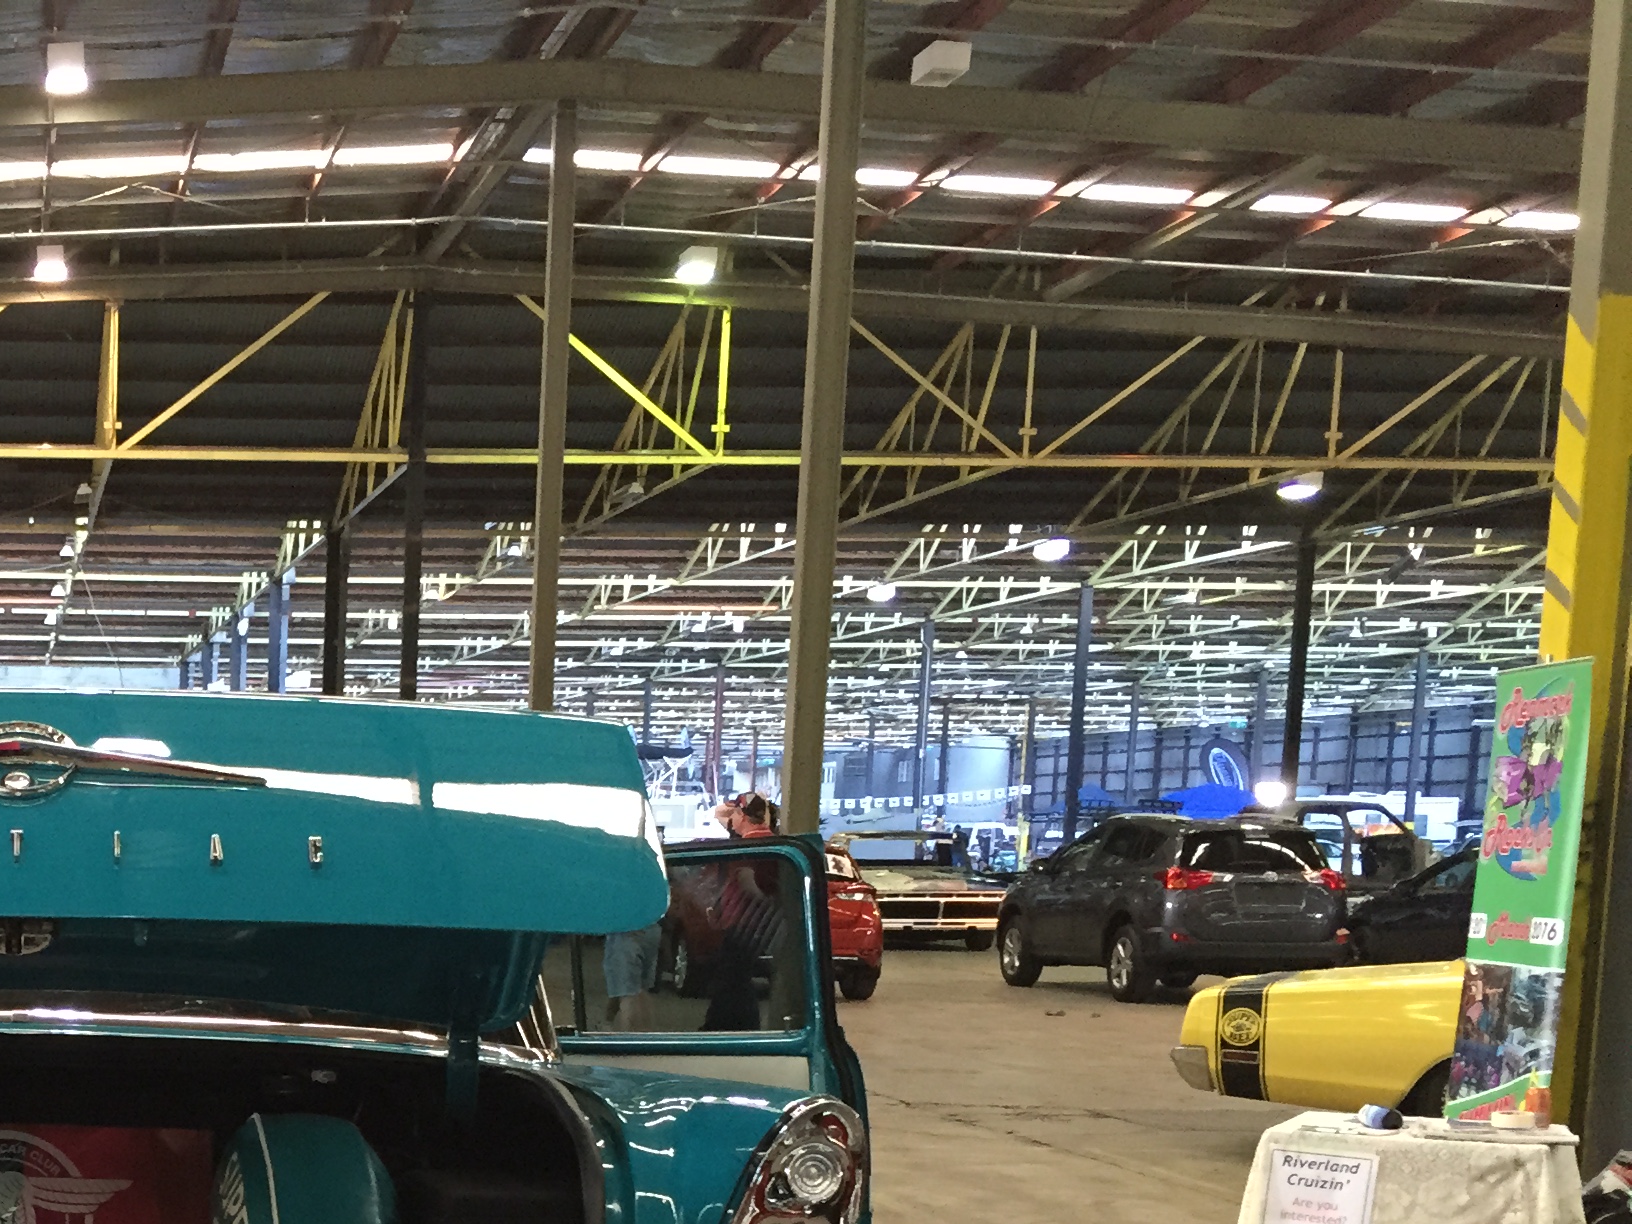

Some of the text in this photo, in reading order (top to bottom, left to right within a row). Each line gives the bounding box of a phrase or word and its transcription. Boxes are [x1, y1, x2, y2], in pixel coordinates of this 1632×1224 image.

[1282, 1154, 1361, 1175] Riverland
[1286, 1173, 1351, 1191] Cruizin'
[1292, 1197, 1339, 1212] Are you
